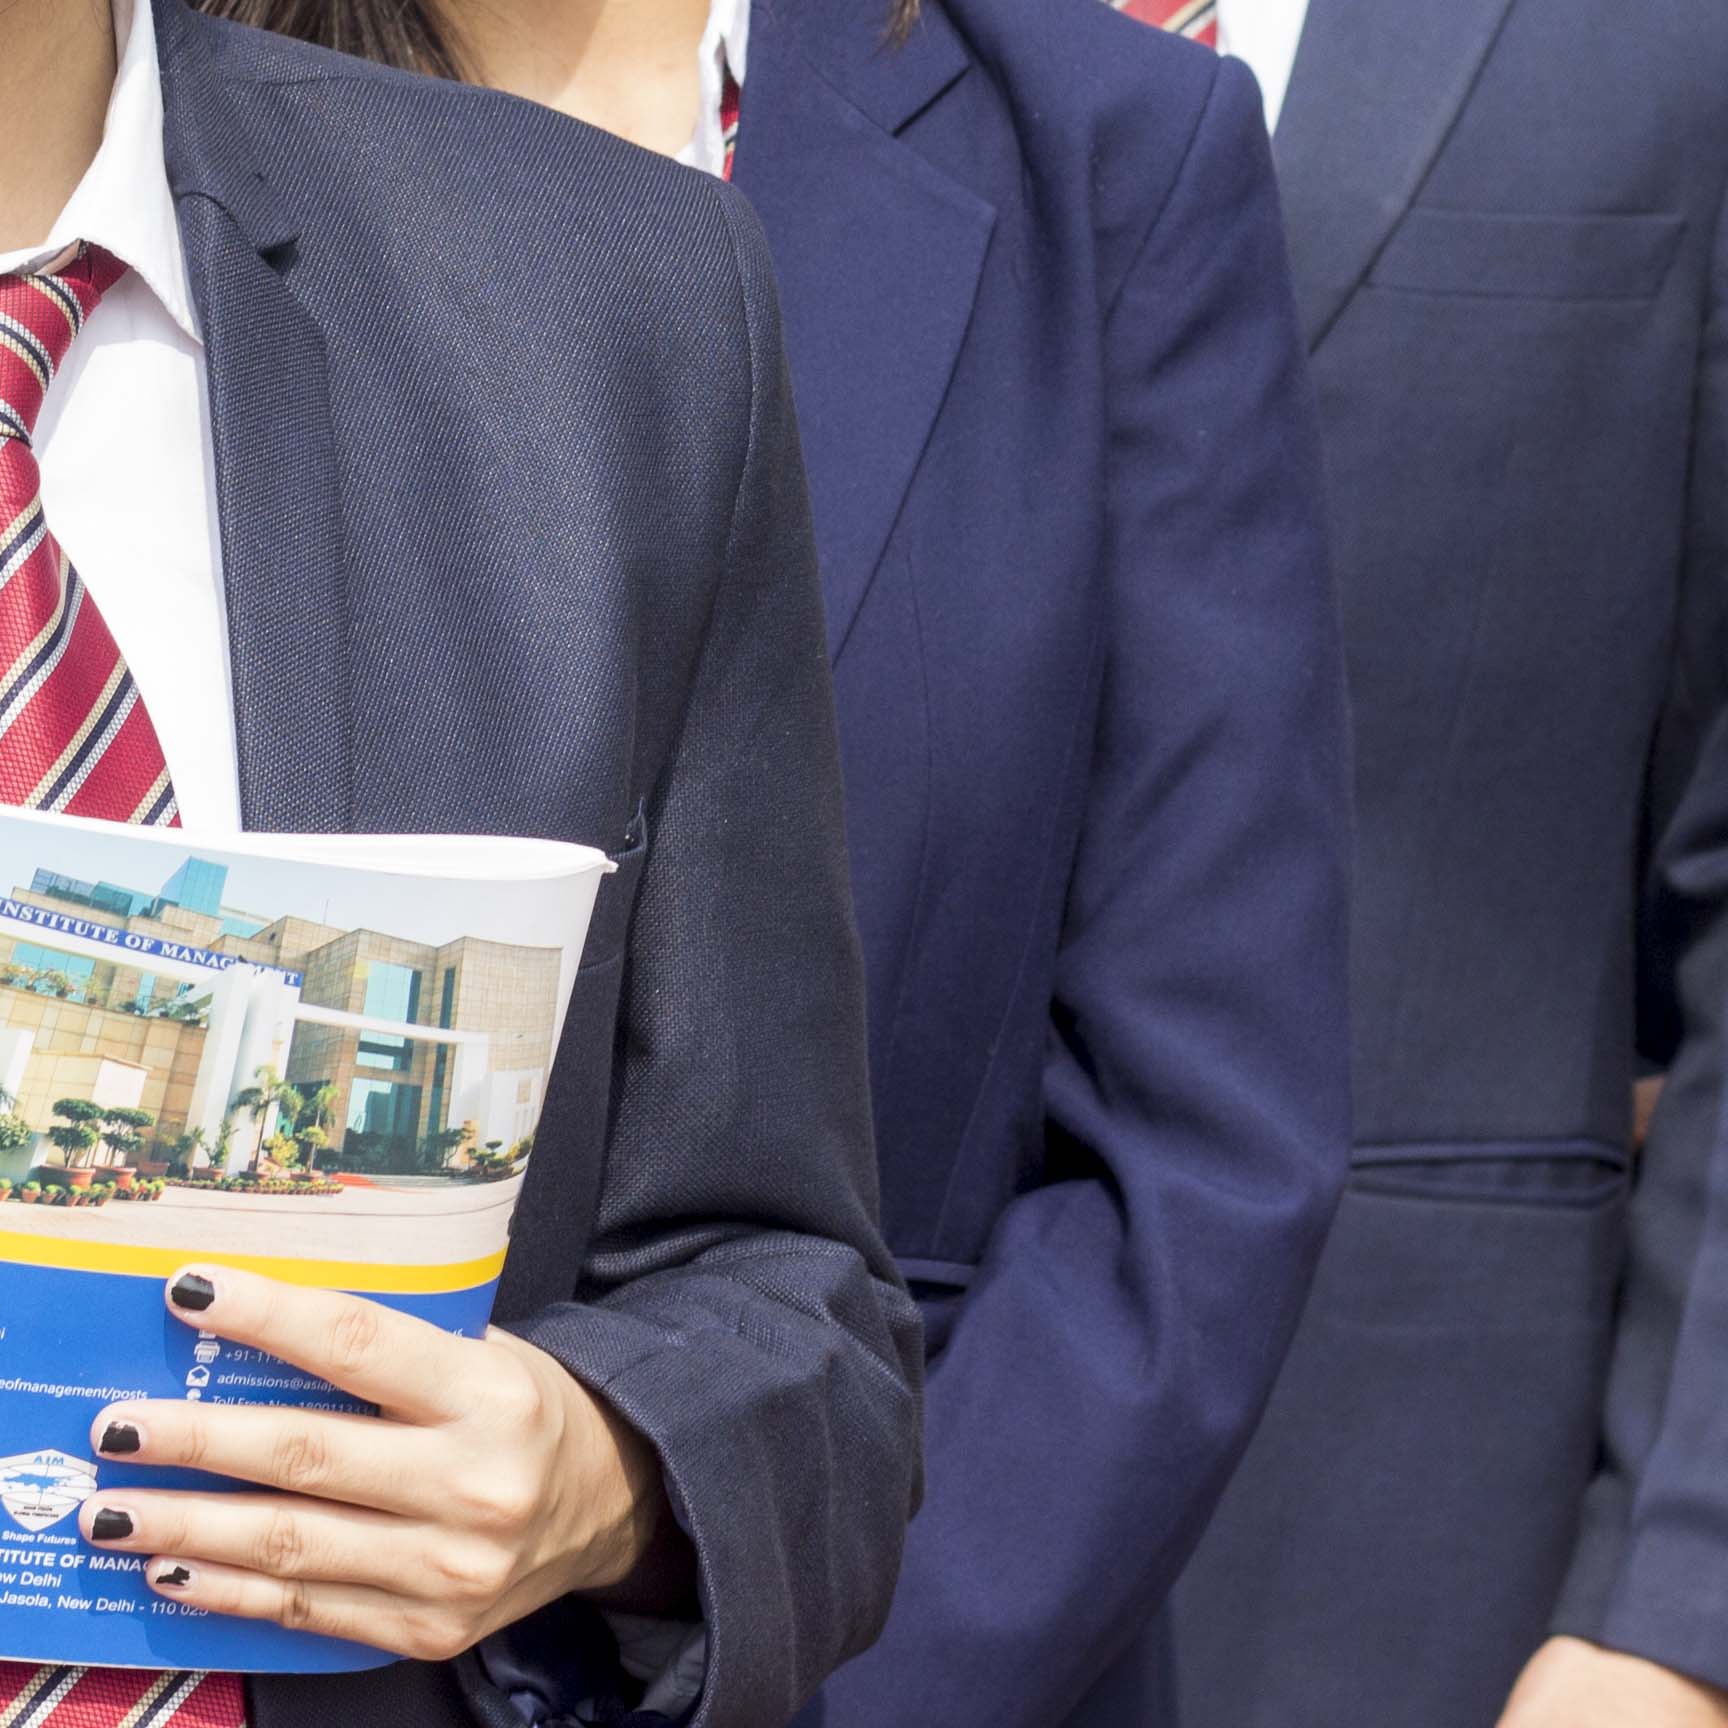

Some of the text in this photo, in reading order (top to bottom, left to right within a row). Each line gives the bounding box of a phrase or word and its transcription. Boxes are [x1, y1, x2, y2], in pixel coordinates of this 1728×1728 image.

[124, 933, 154, 953] OF
[33, 1455, 65, 1465] AIM
[2, 1529, 35, 1543] Shape
[37, 1533, 77, 1545] Futures
[60, 1553, 87, 1569] OF
[20, 1571, 62, 1588] Delhi
[57, 1595, 92, 1611] New
[96, 1597, 135, 1613] Delhi
[151, 1600, 177, 1615] 110
